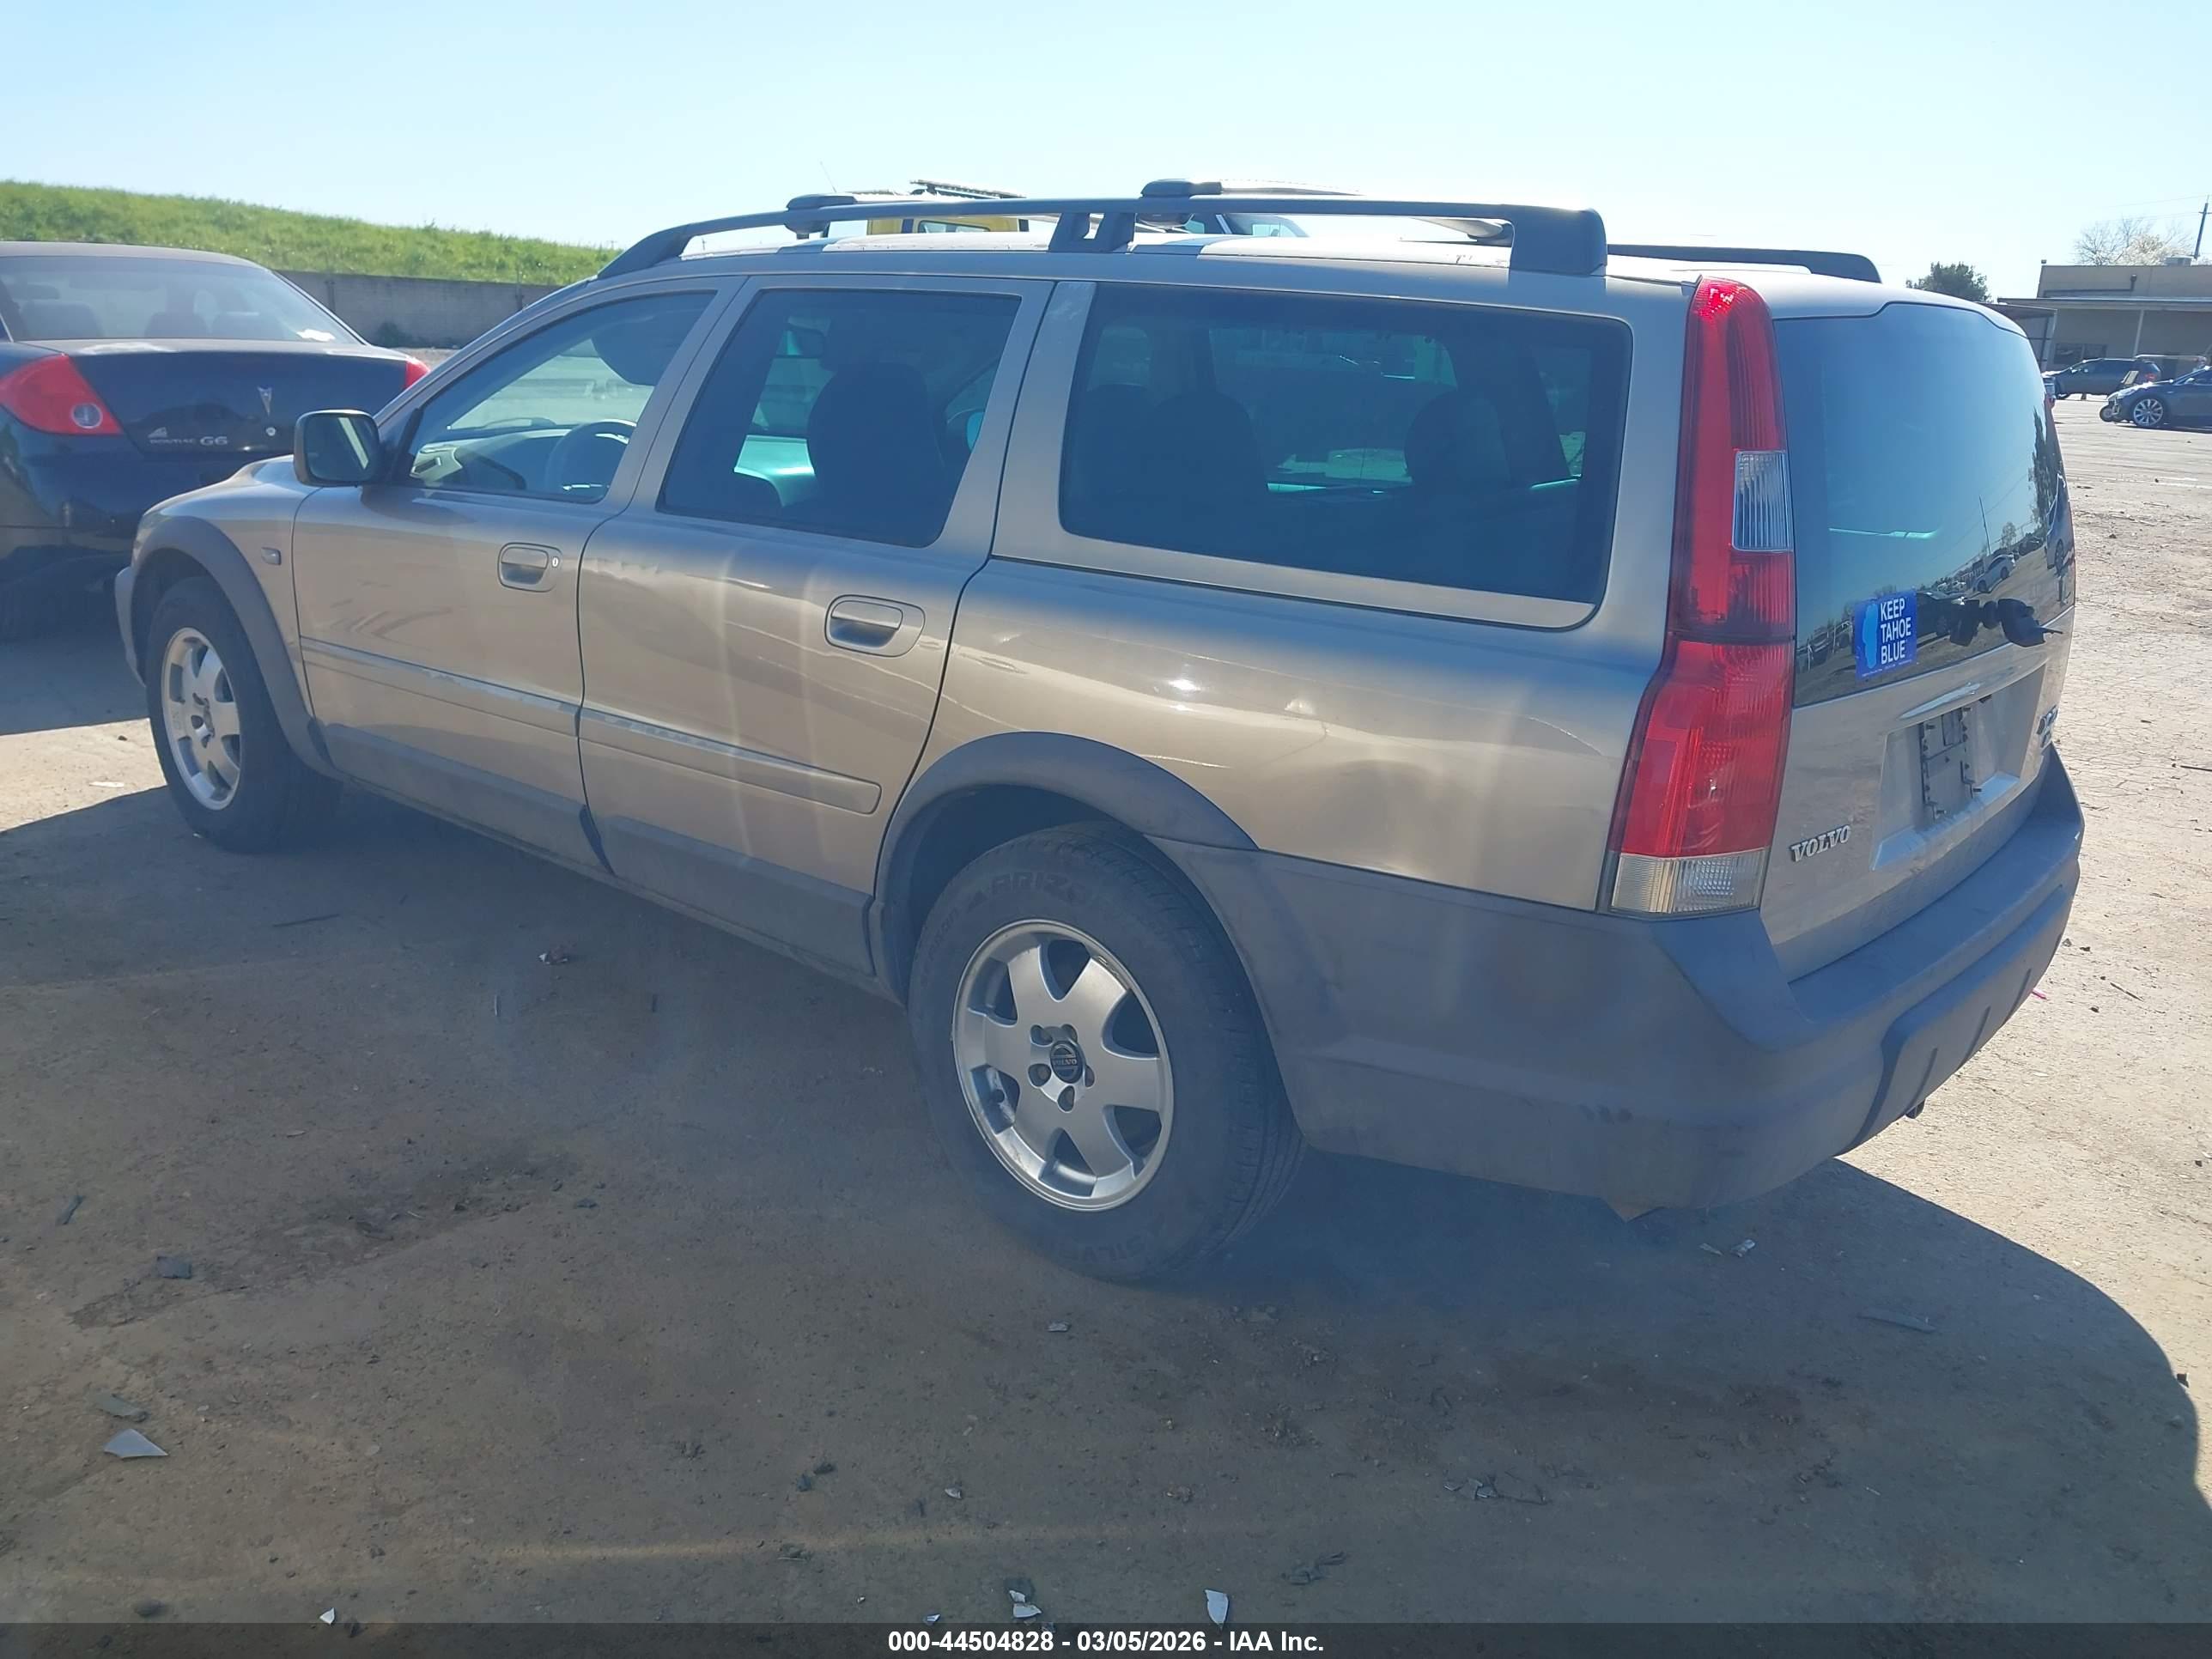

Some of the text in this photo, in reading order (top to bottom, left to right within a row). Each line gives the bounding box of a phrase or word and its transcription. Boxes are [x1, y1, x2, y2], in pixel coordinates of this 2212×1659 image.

[200, 435, 228, 446] G6
[1880, 598, 1905, 622] KEEP
[1880, 617, 1911, 643] TAHOE
[1881, 640, 1905, 665] BLUE
[1791, 825, 1850, 862] VOLVO
